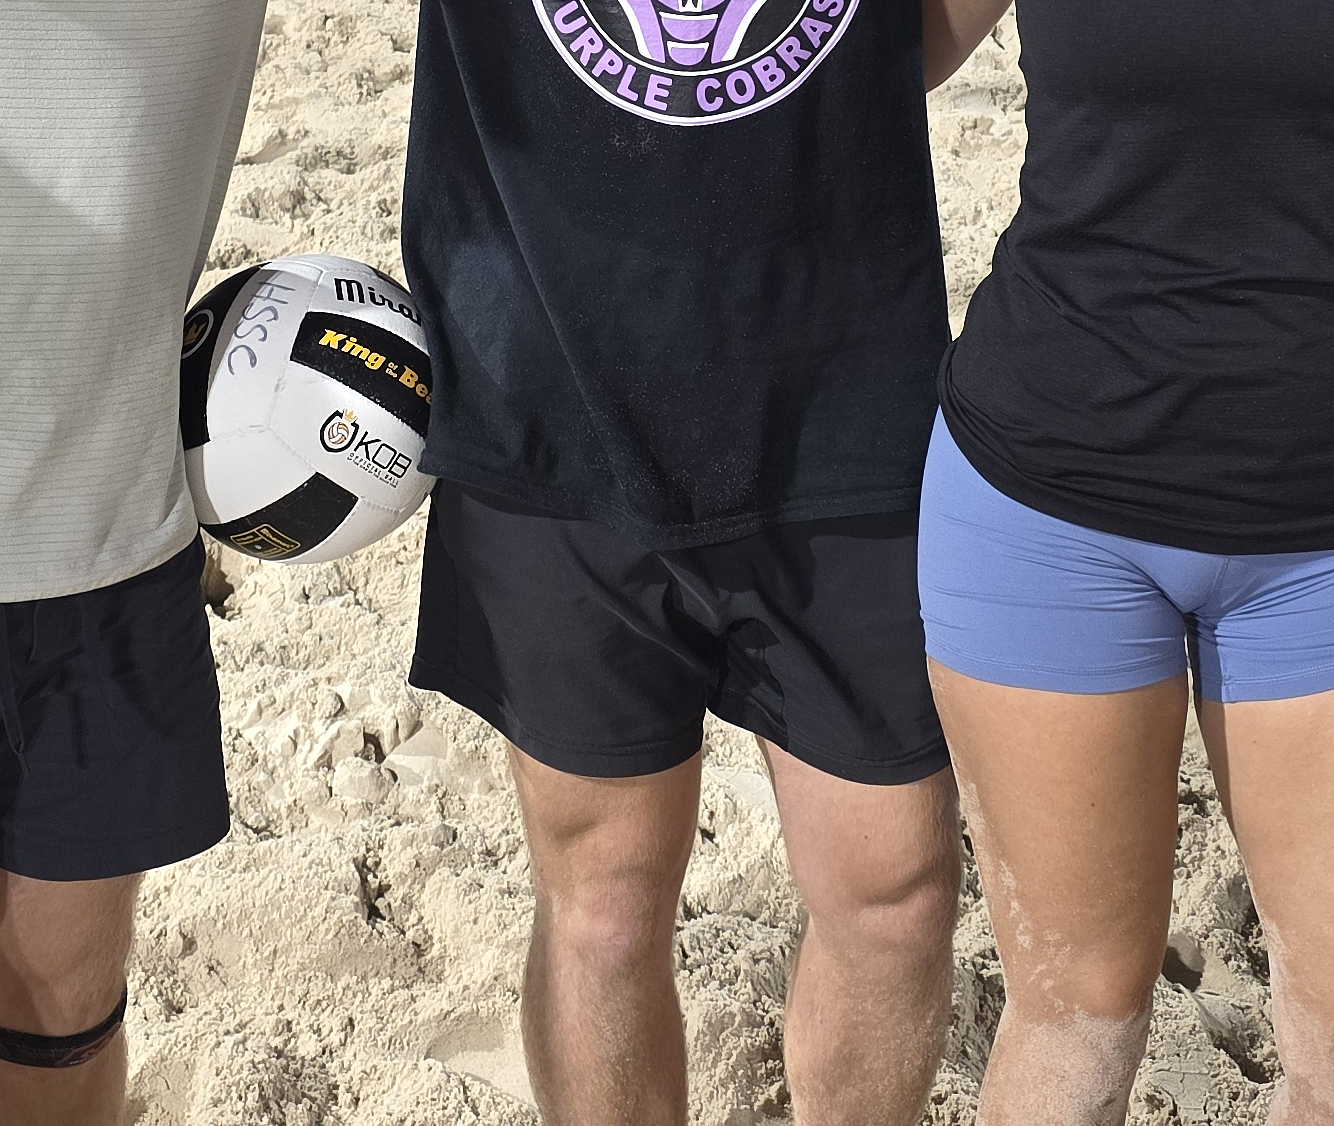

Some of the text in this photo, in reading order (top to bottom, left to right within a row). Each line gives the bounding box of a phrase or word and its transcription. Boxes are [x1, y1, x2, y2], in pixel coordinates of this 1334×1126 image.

[333, 277, 422, 327] Mira
[227, 279, 296, 376] HSSC
[318, 328, 387, 370] King
[353, 430, 413, 479] KOB
